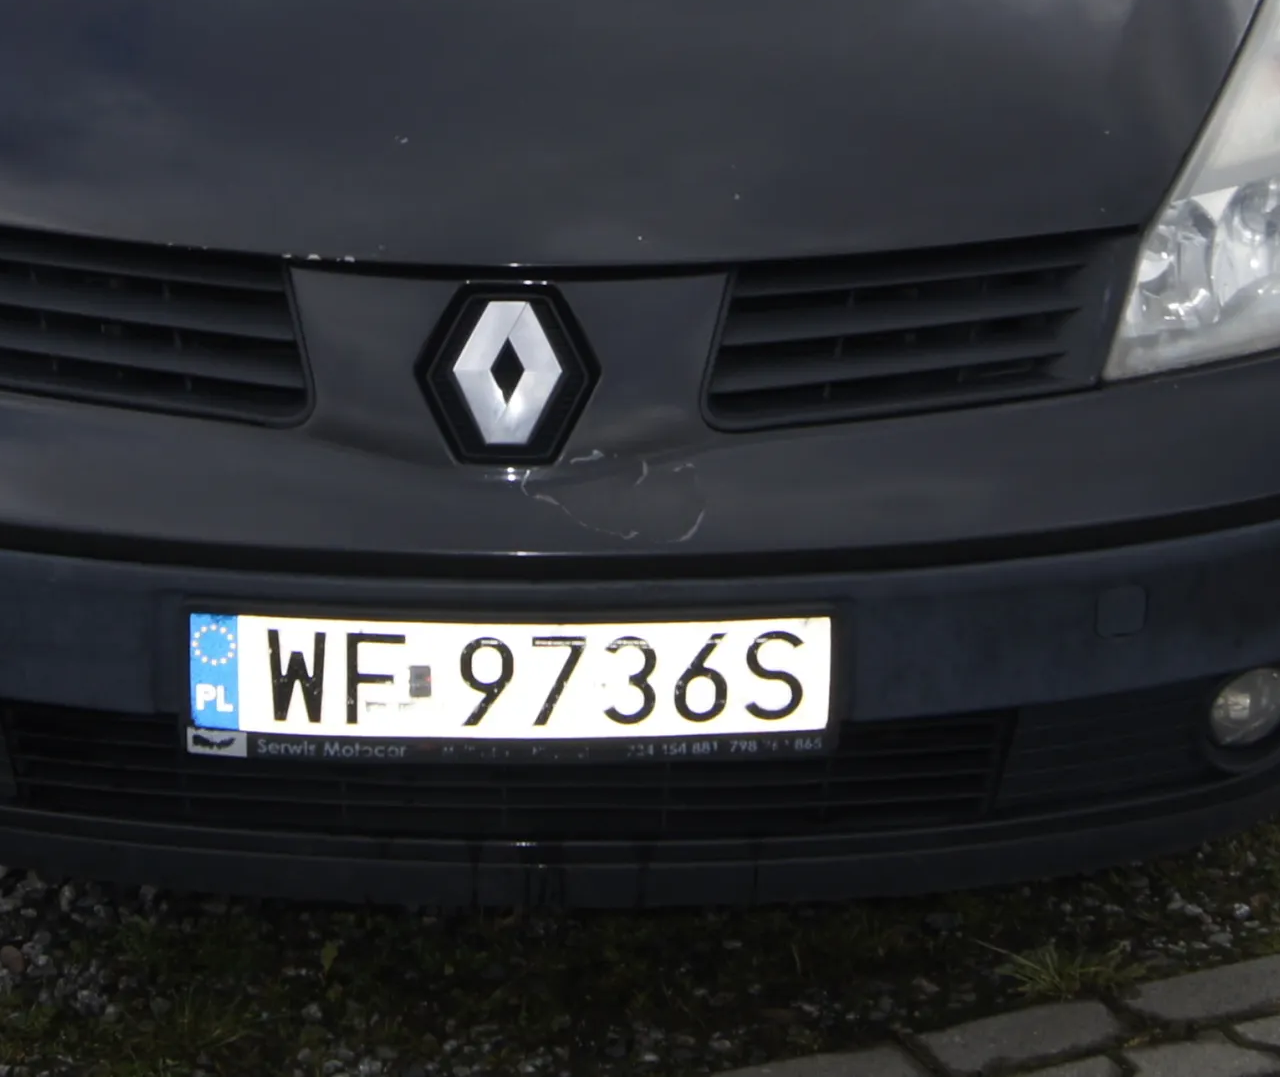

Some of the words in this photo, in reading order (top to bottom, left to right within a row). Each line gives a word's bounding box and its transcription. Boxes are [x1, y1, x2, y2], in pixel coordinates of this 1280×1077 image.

[195, 682, 235, 713] PL
[267, 628, 406, 725] WF
[459, 629, 805, 727] 9736S
